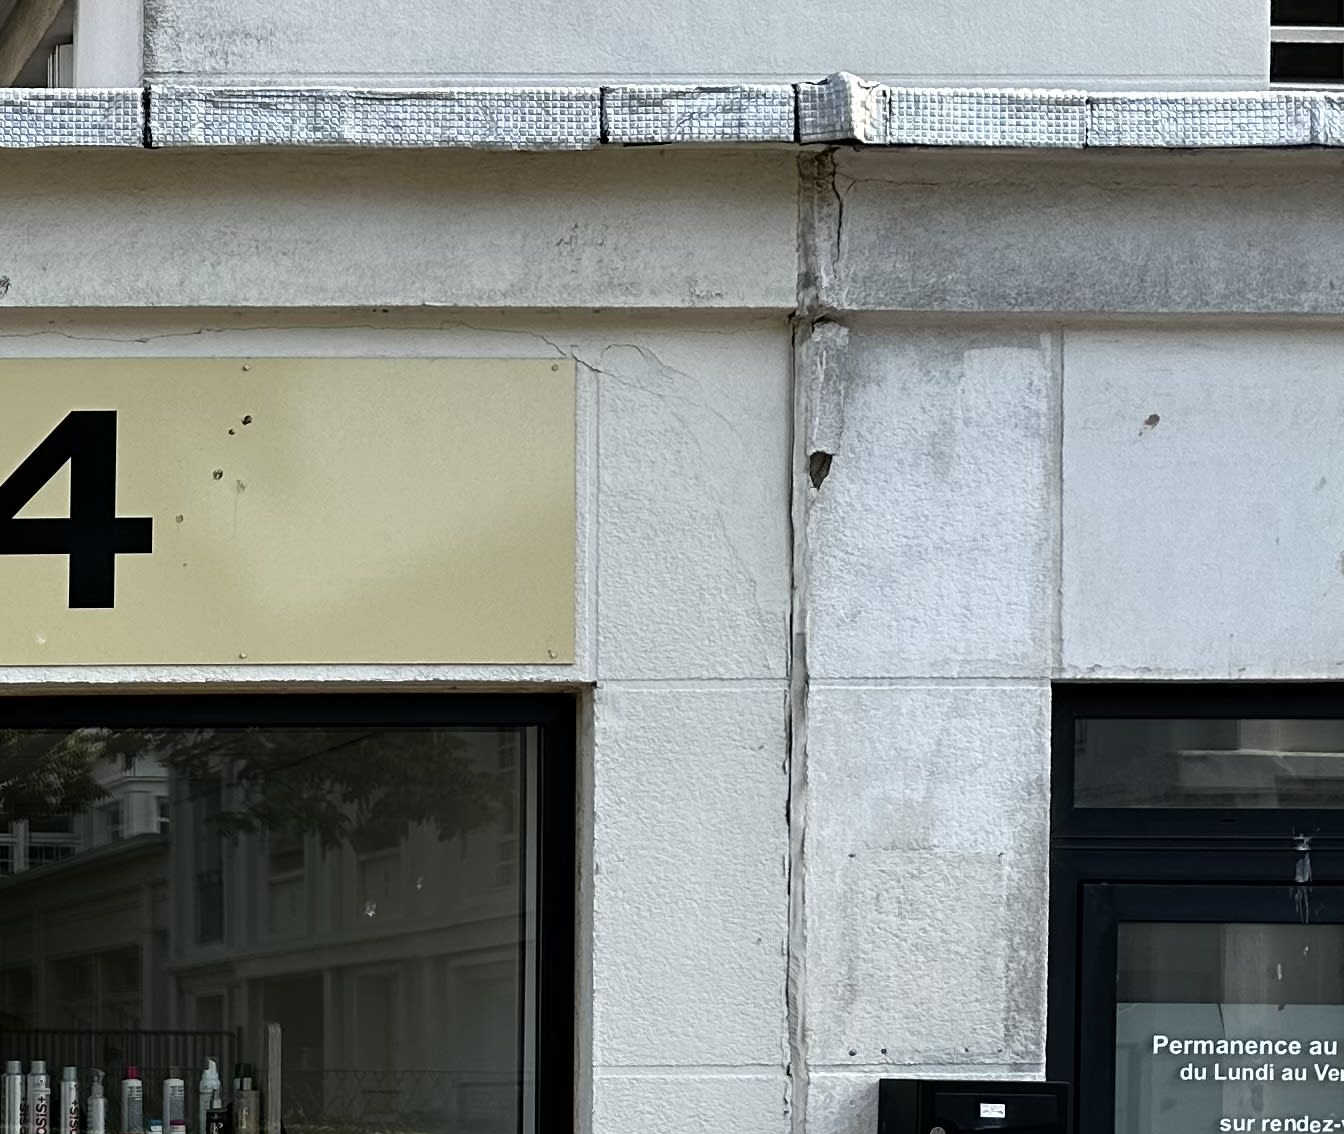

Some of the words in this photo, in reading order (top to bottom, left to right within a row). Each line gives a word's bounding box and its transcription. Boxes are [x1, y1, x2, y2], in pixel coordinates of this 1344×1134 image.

[1153, 1035, 1302, 1056] Permanence
[1309, 1040, 1337, 1056] au
[1180, 1063, 1207, 1082] du
[1214, 1063, 1274, 1082] Lundi
[1281, 1067, 1307, 1082] au
[1220, 1118, 1256, 1132] sur
[1261, 1115, 1344, 1134] rendez-
